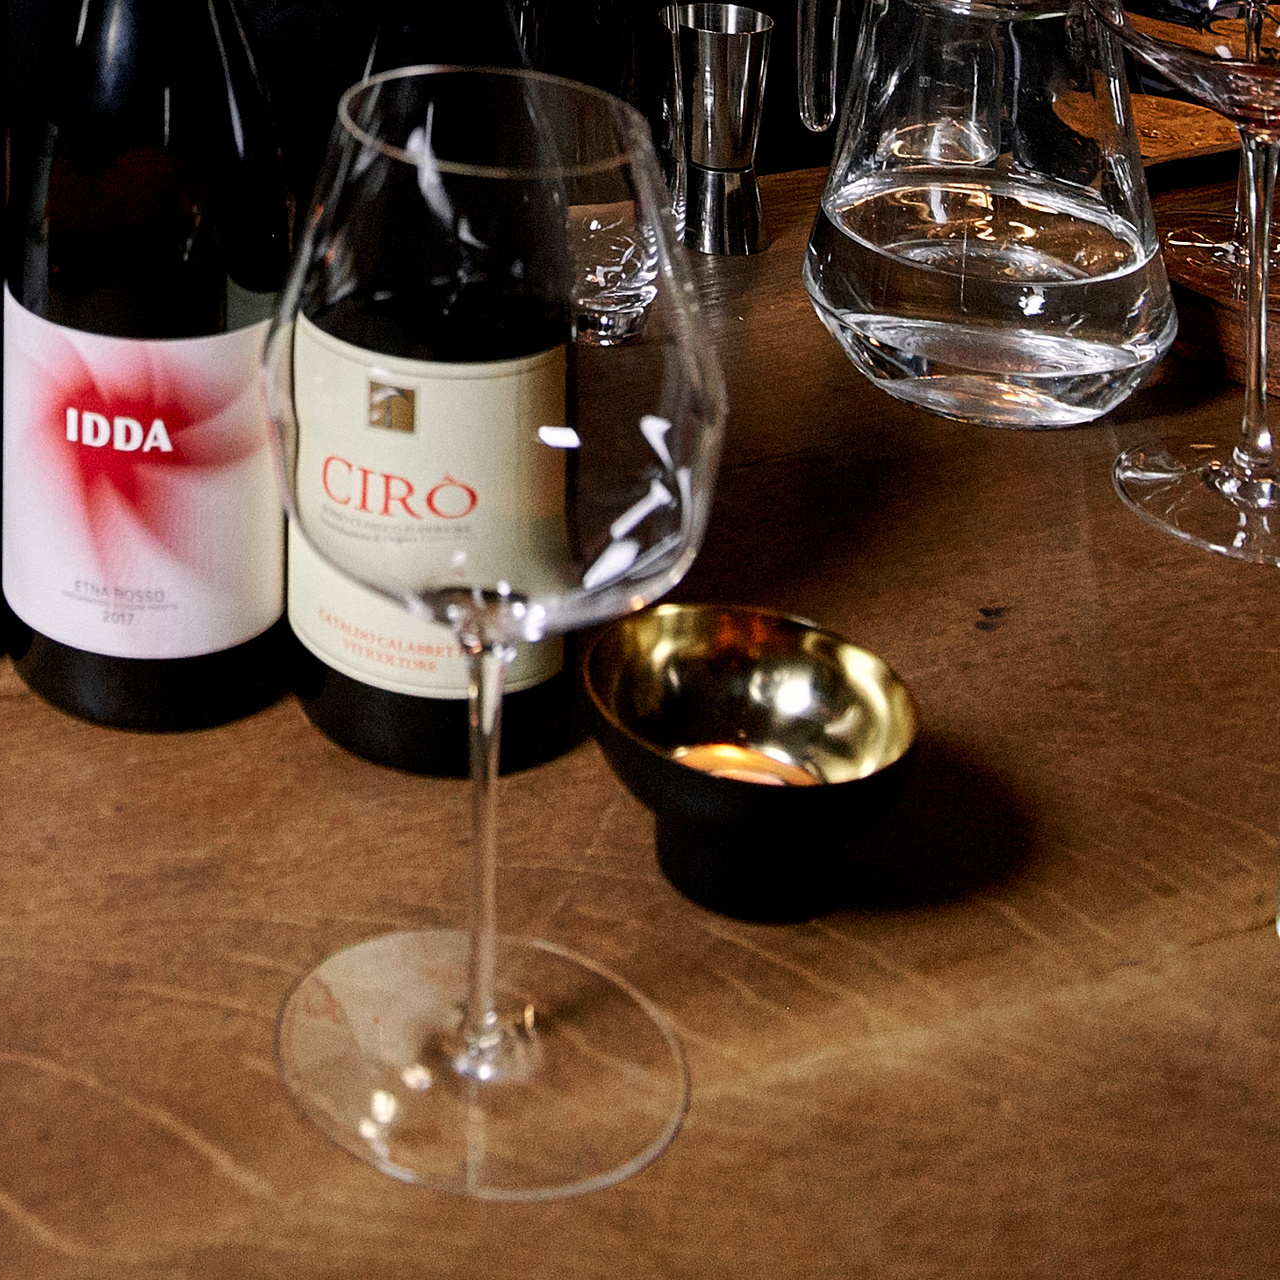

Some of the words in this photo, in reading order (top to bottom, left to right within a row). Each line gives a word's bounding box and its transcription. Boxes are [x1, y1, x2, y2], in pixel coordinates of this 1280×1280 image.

[65, 406, 174, 454] IDDA
[322, 454, 479, 520] CIRÒ
[74, 579, 110, 598] ETNA
[113, 587, 165, 604] ROSSO
[102, 609, 136, 626] 2017
